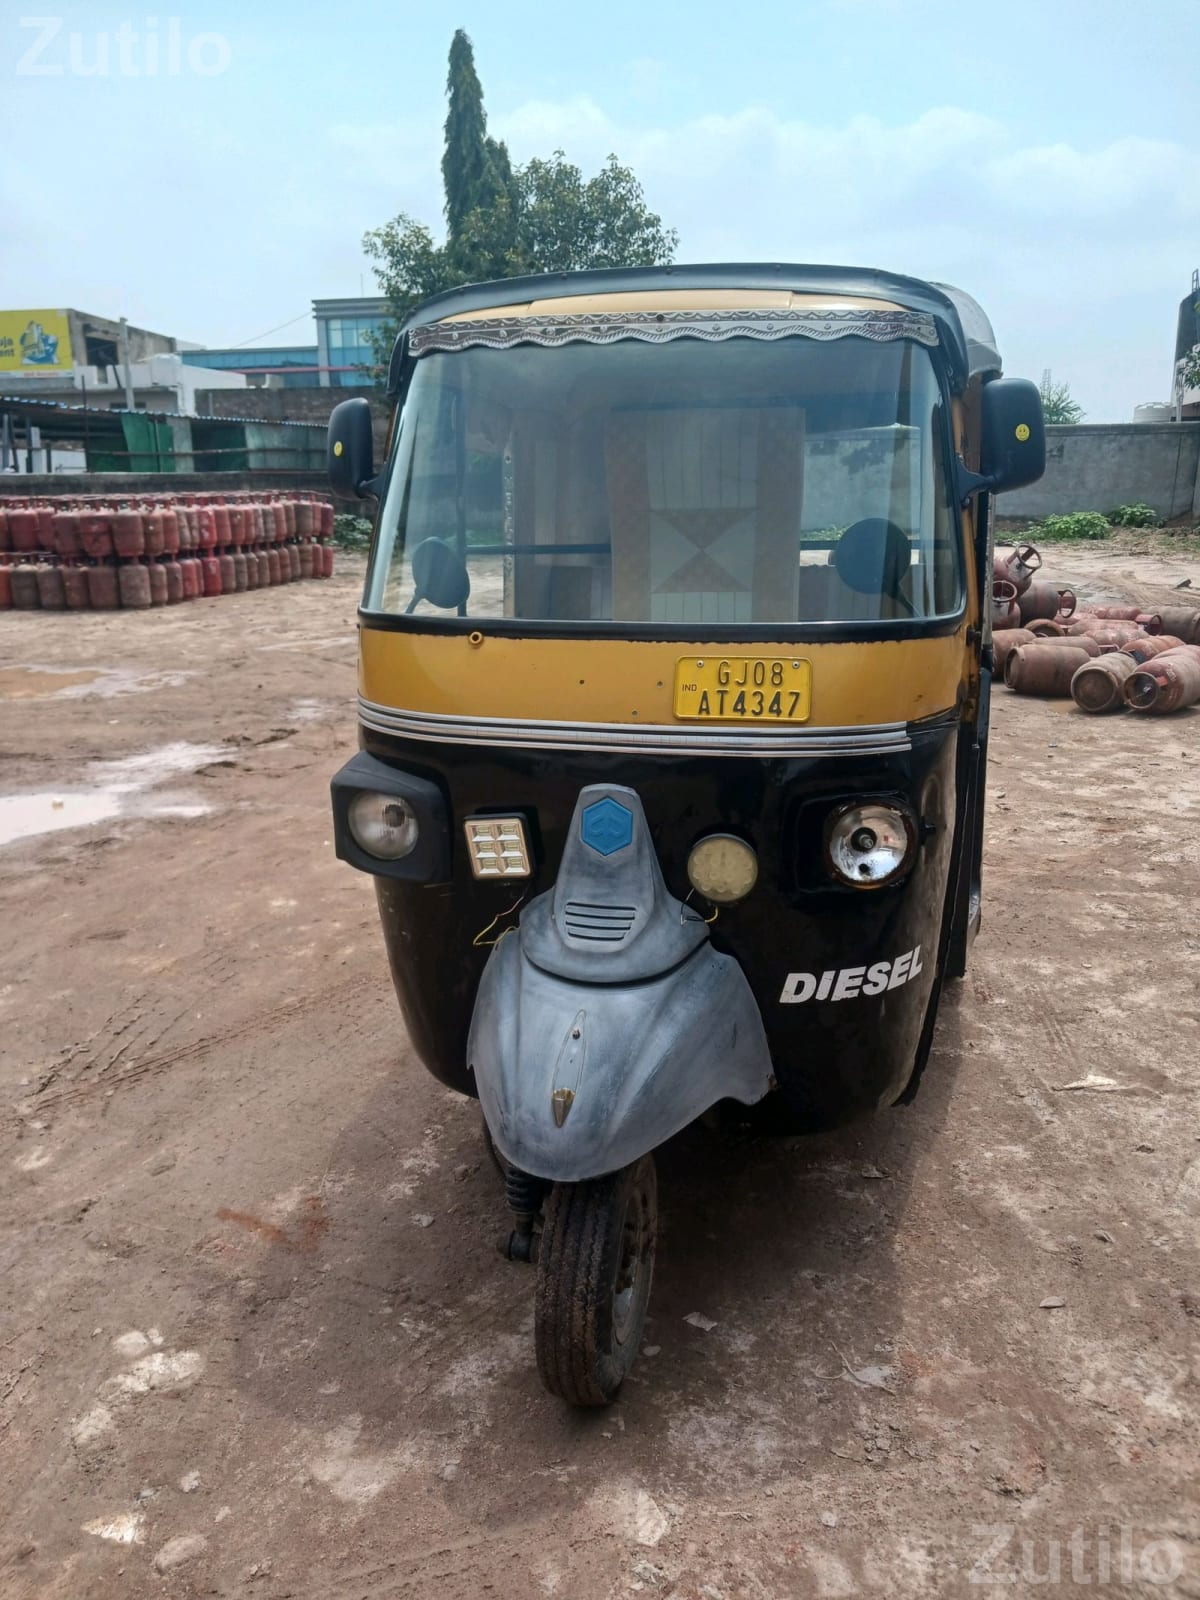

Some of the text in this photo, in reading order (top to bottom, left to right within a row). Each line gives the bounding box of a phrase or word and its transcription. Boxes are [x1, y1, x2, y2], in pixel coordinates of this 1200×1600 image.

[718, 660, 784, 686] GJ08
[681, 683, 698, 692] IND
[698, 689, 801, 717] AT4347
[779, 944, 924, 1004] DIESEL
